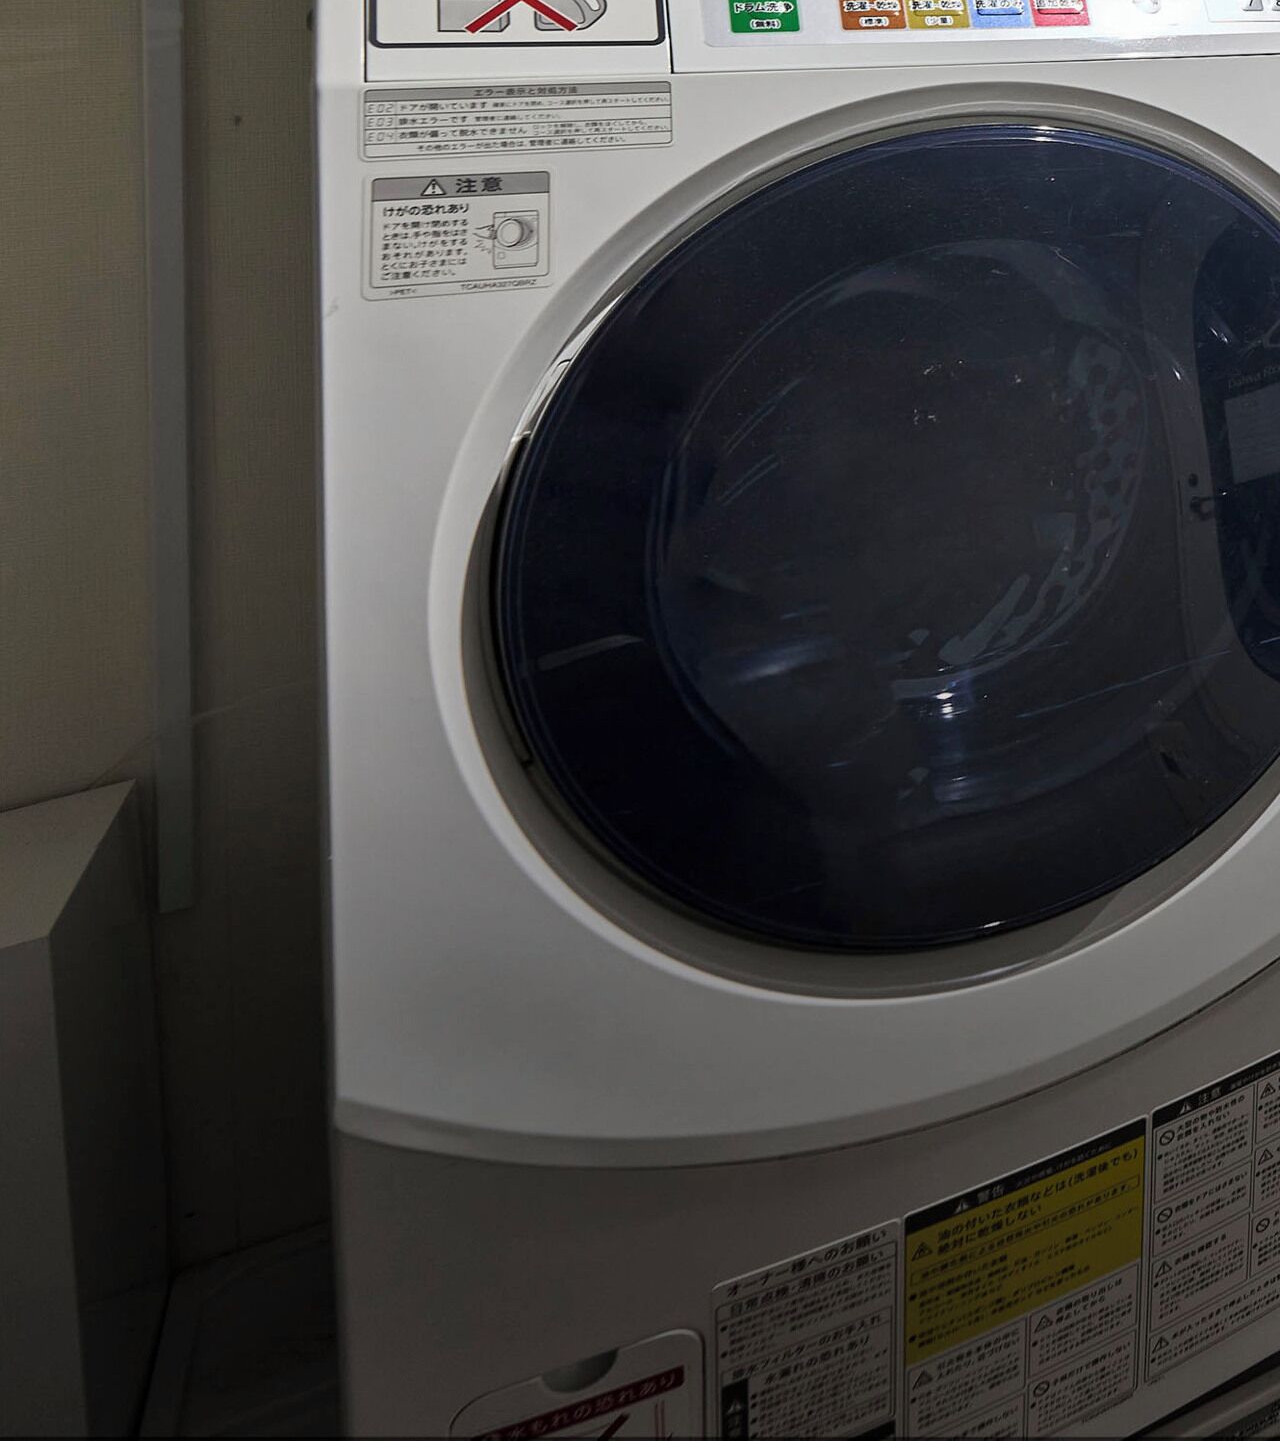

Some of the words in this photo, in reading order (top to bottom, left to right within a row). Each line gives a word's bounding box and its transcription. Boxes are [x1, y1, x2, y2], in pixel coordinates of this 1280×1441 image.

[455, 176, 504, 194] 注意
[382, 203, 469, 217] けがの恐れあり
